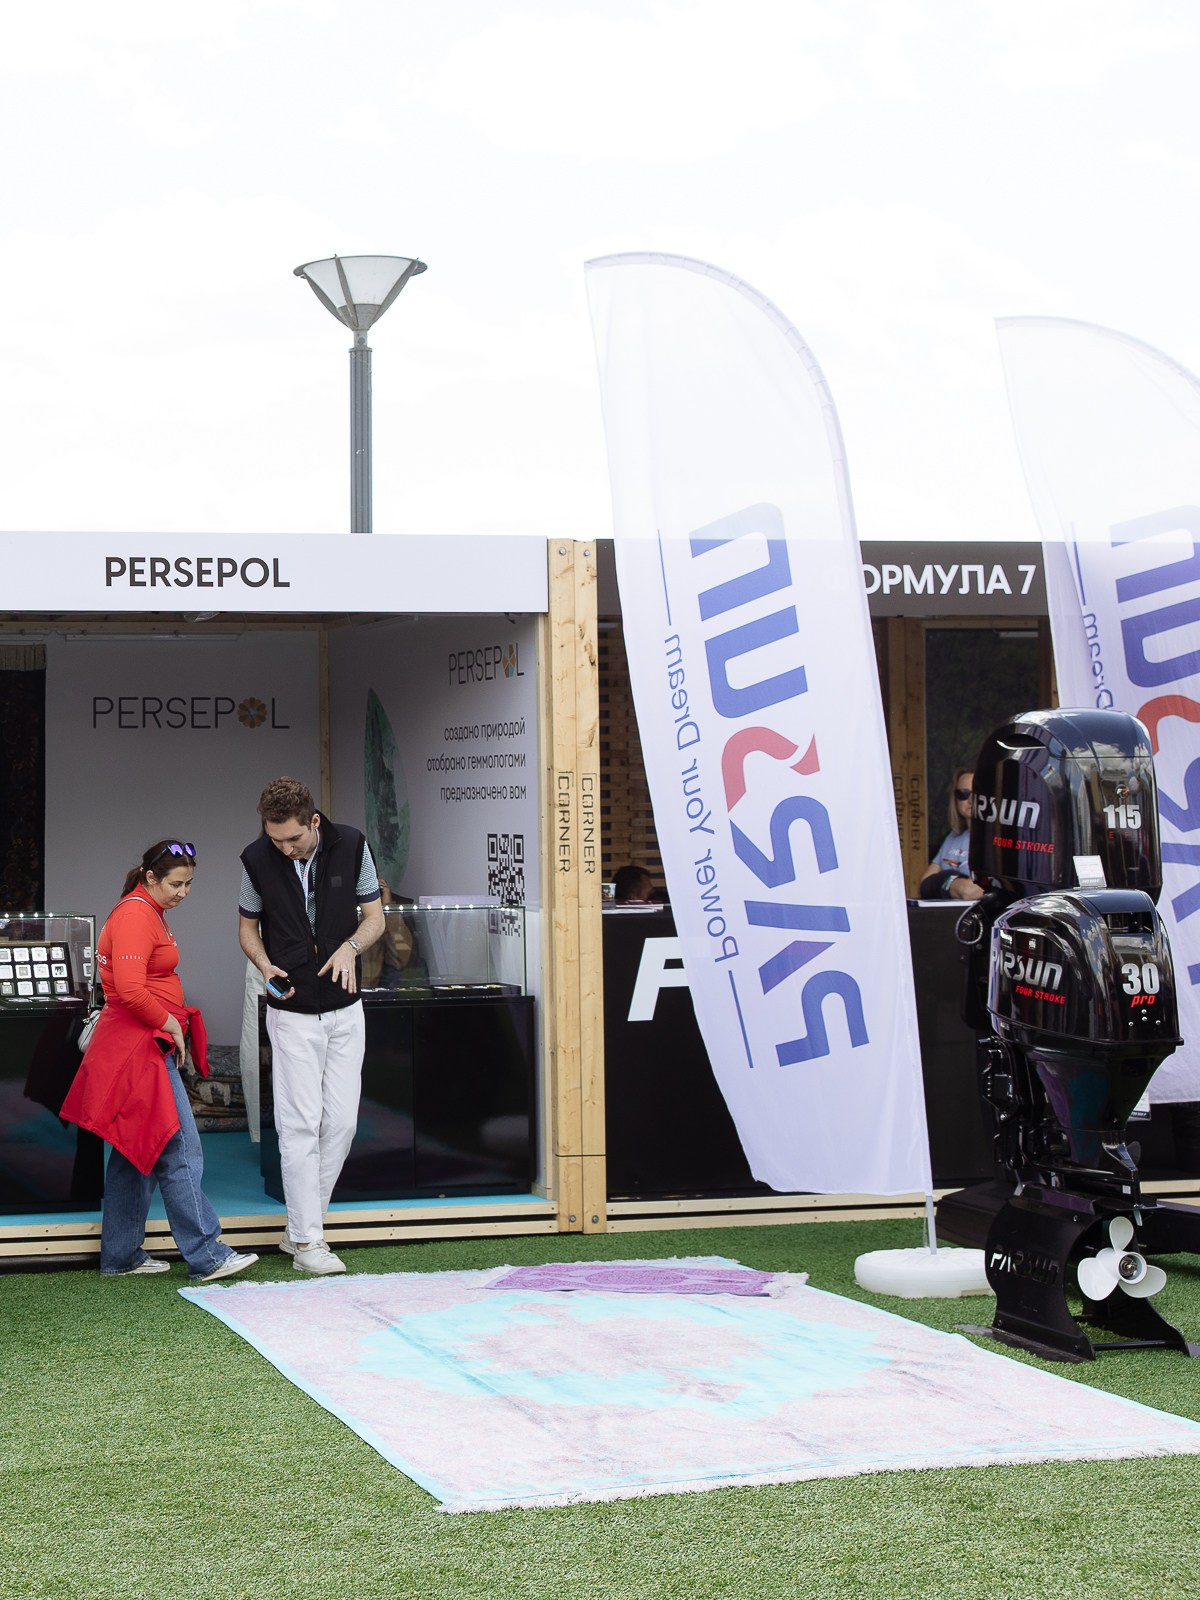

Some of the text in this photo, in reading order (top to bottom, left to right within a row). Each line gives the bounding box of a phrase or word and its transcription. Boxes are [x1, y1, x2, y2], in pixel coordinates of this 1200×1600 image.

[105, 557, 290, 588] PERSEPOL
[861, 563, 1037, 595] ОРМУЛА 7
[443, 717, 526, 742] создано природой
[426, 752, 526, 774] отобрано геммологами
[440, 784, 527, 804] предназначено вам
[557, 775, 571, 873] CORNER
[973, 794, 1041, 829] RSUN
[1102, 804, 1142, 830] 115
[581, 777, 596, 874] CORNER
[993, 836, 1055, 854] FOUR STROKE
[1121, 962, 1160, 995] 30
[1015, 985, 1066, 1005] FOUR STROKE
[1130, 995, 1156, 1008] pro
